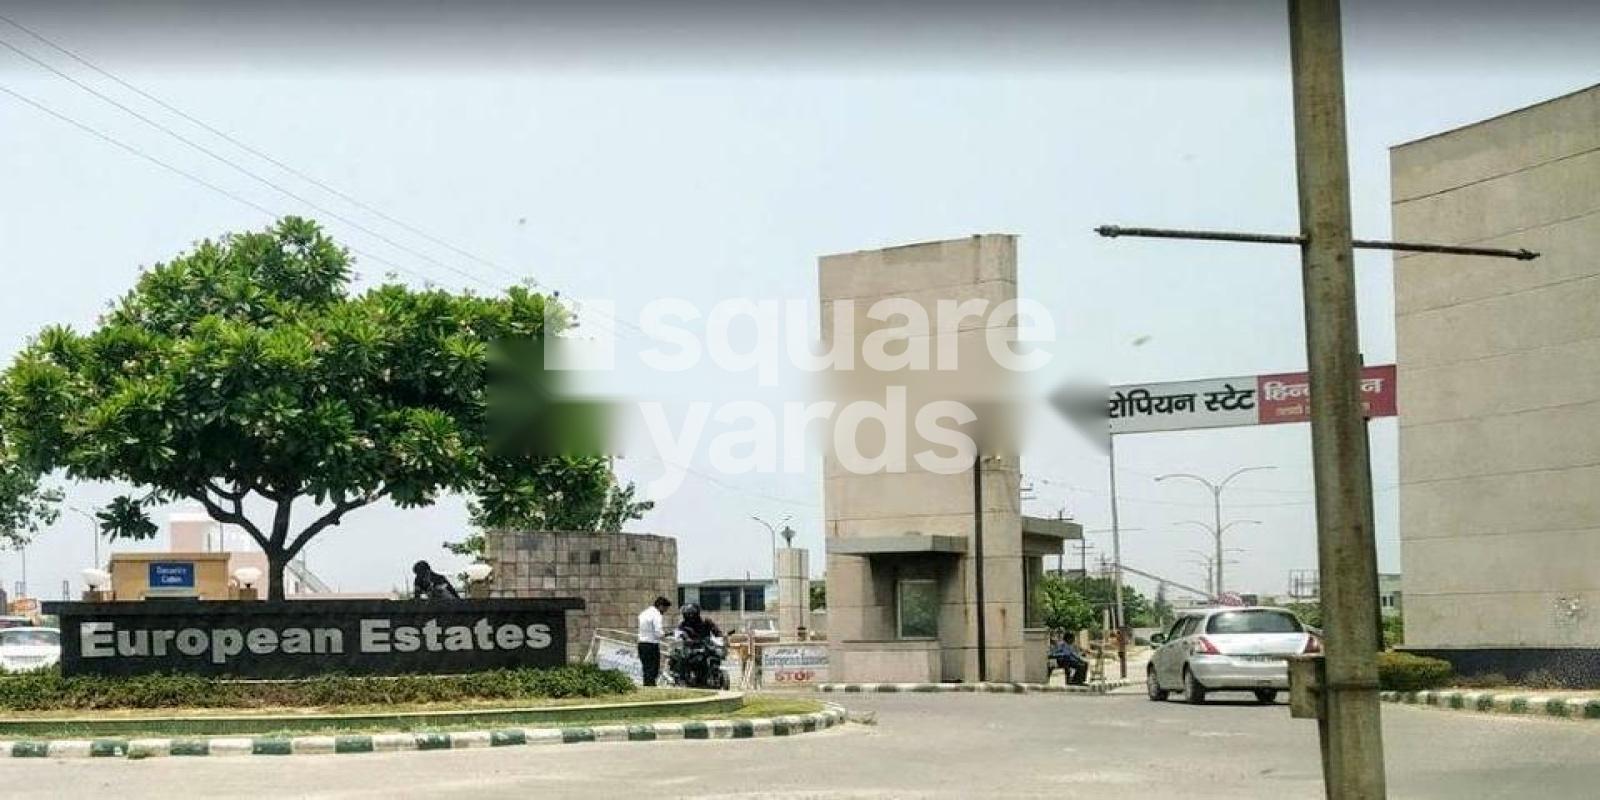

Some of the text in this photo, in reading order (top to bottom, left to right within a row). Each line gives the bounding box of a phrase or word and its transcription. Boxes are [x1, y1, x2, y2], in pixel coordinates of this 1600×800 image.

[1203, 382, 1256, 411] स्टेट
[80, 617, 553, 663] European Estates
[775, 670, 816, 681] STOP
